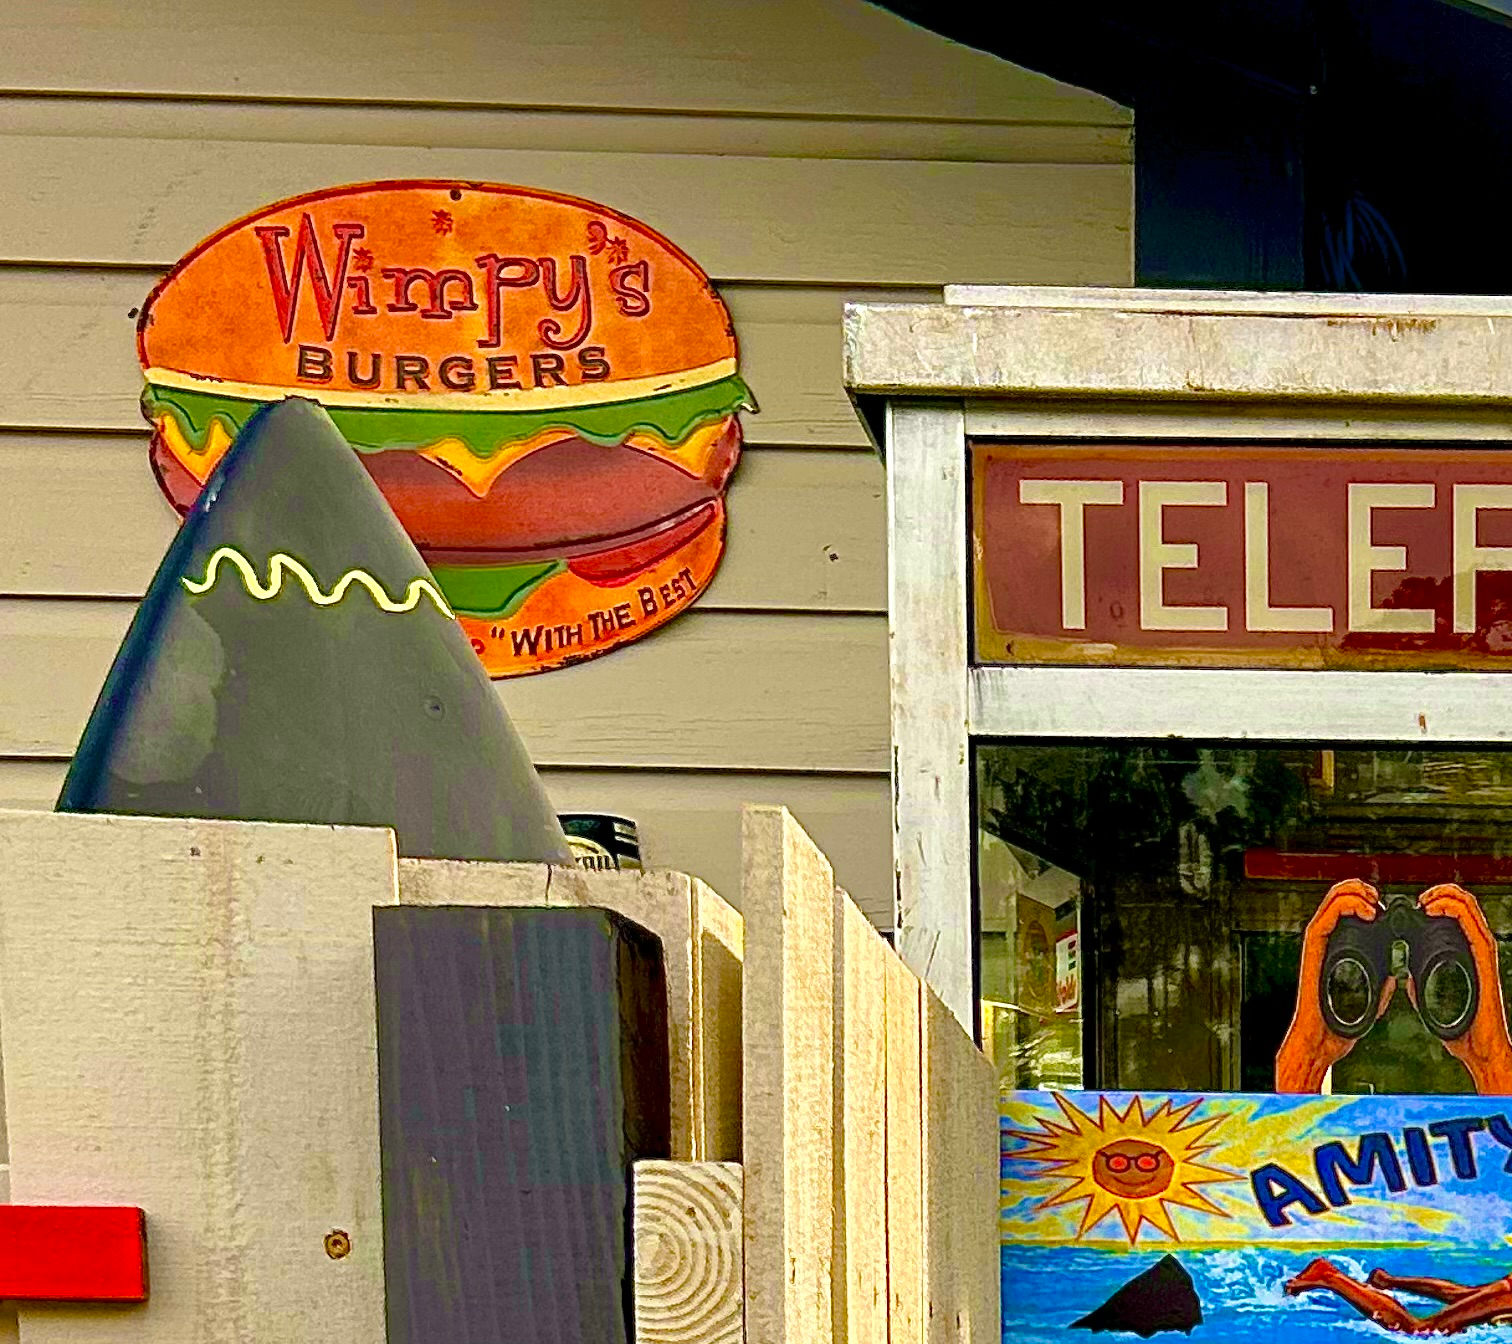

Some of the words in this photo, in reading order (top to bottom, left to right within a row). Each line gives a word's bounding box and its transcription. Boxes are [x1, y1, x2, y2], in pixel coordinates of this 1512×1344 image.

[255, 211, 651, 351] Wimpy's
[296, 344, 611, 391] BURGERS
[588, 602, 636, 641] THE
